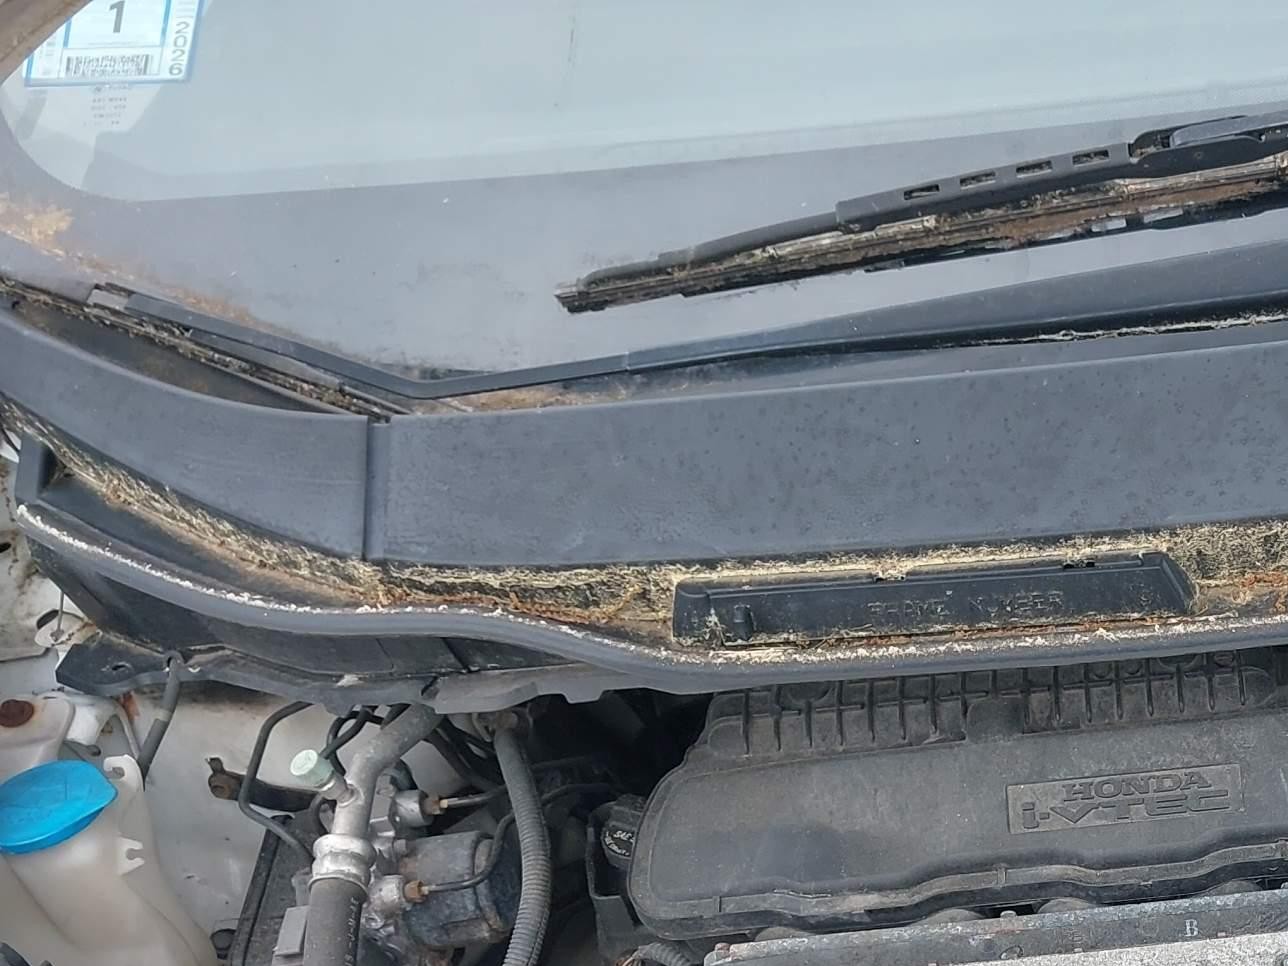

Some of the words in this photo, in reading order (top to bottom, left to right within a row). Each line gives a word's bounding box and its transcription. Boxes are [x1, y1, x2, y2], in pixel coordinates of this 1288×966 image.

[109, 1, 125, 33] 1
[1062, 771, 1212, 802] HONDA
[1021, 788, 1230, 829] i-VTEC
[1184, 919, 1199, 937] B
